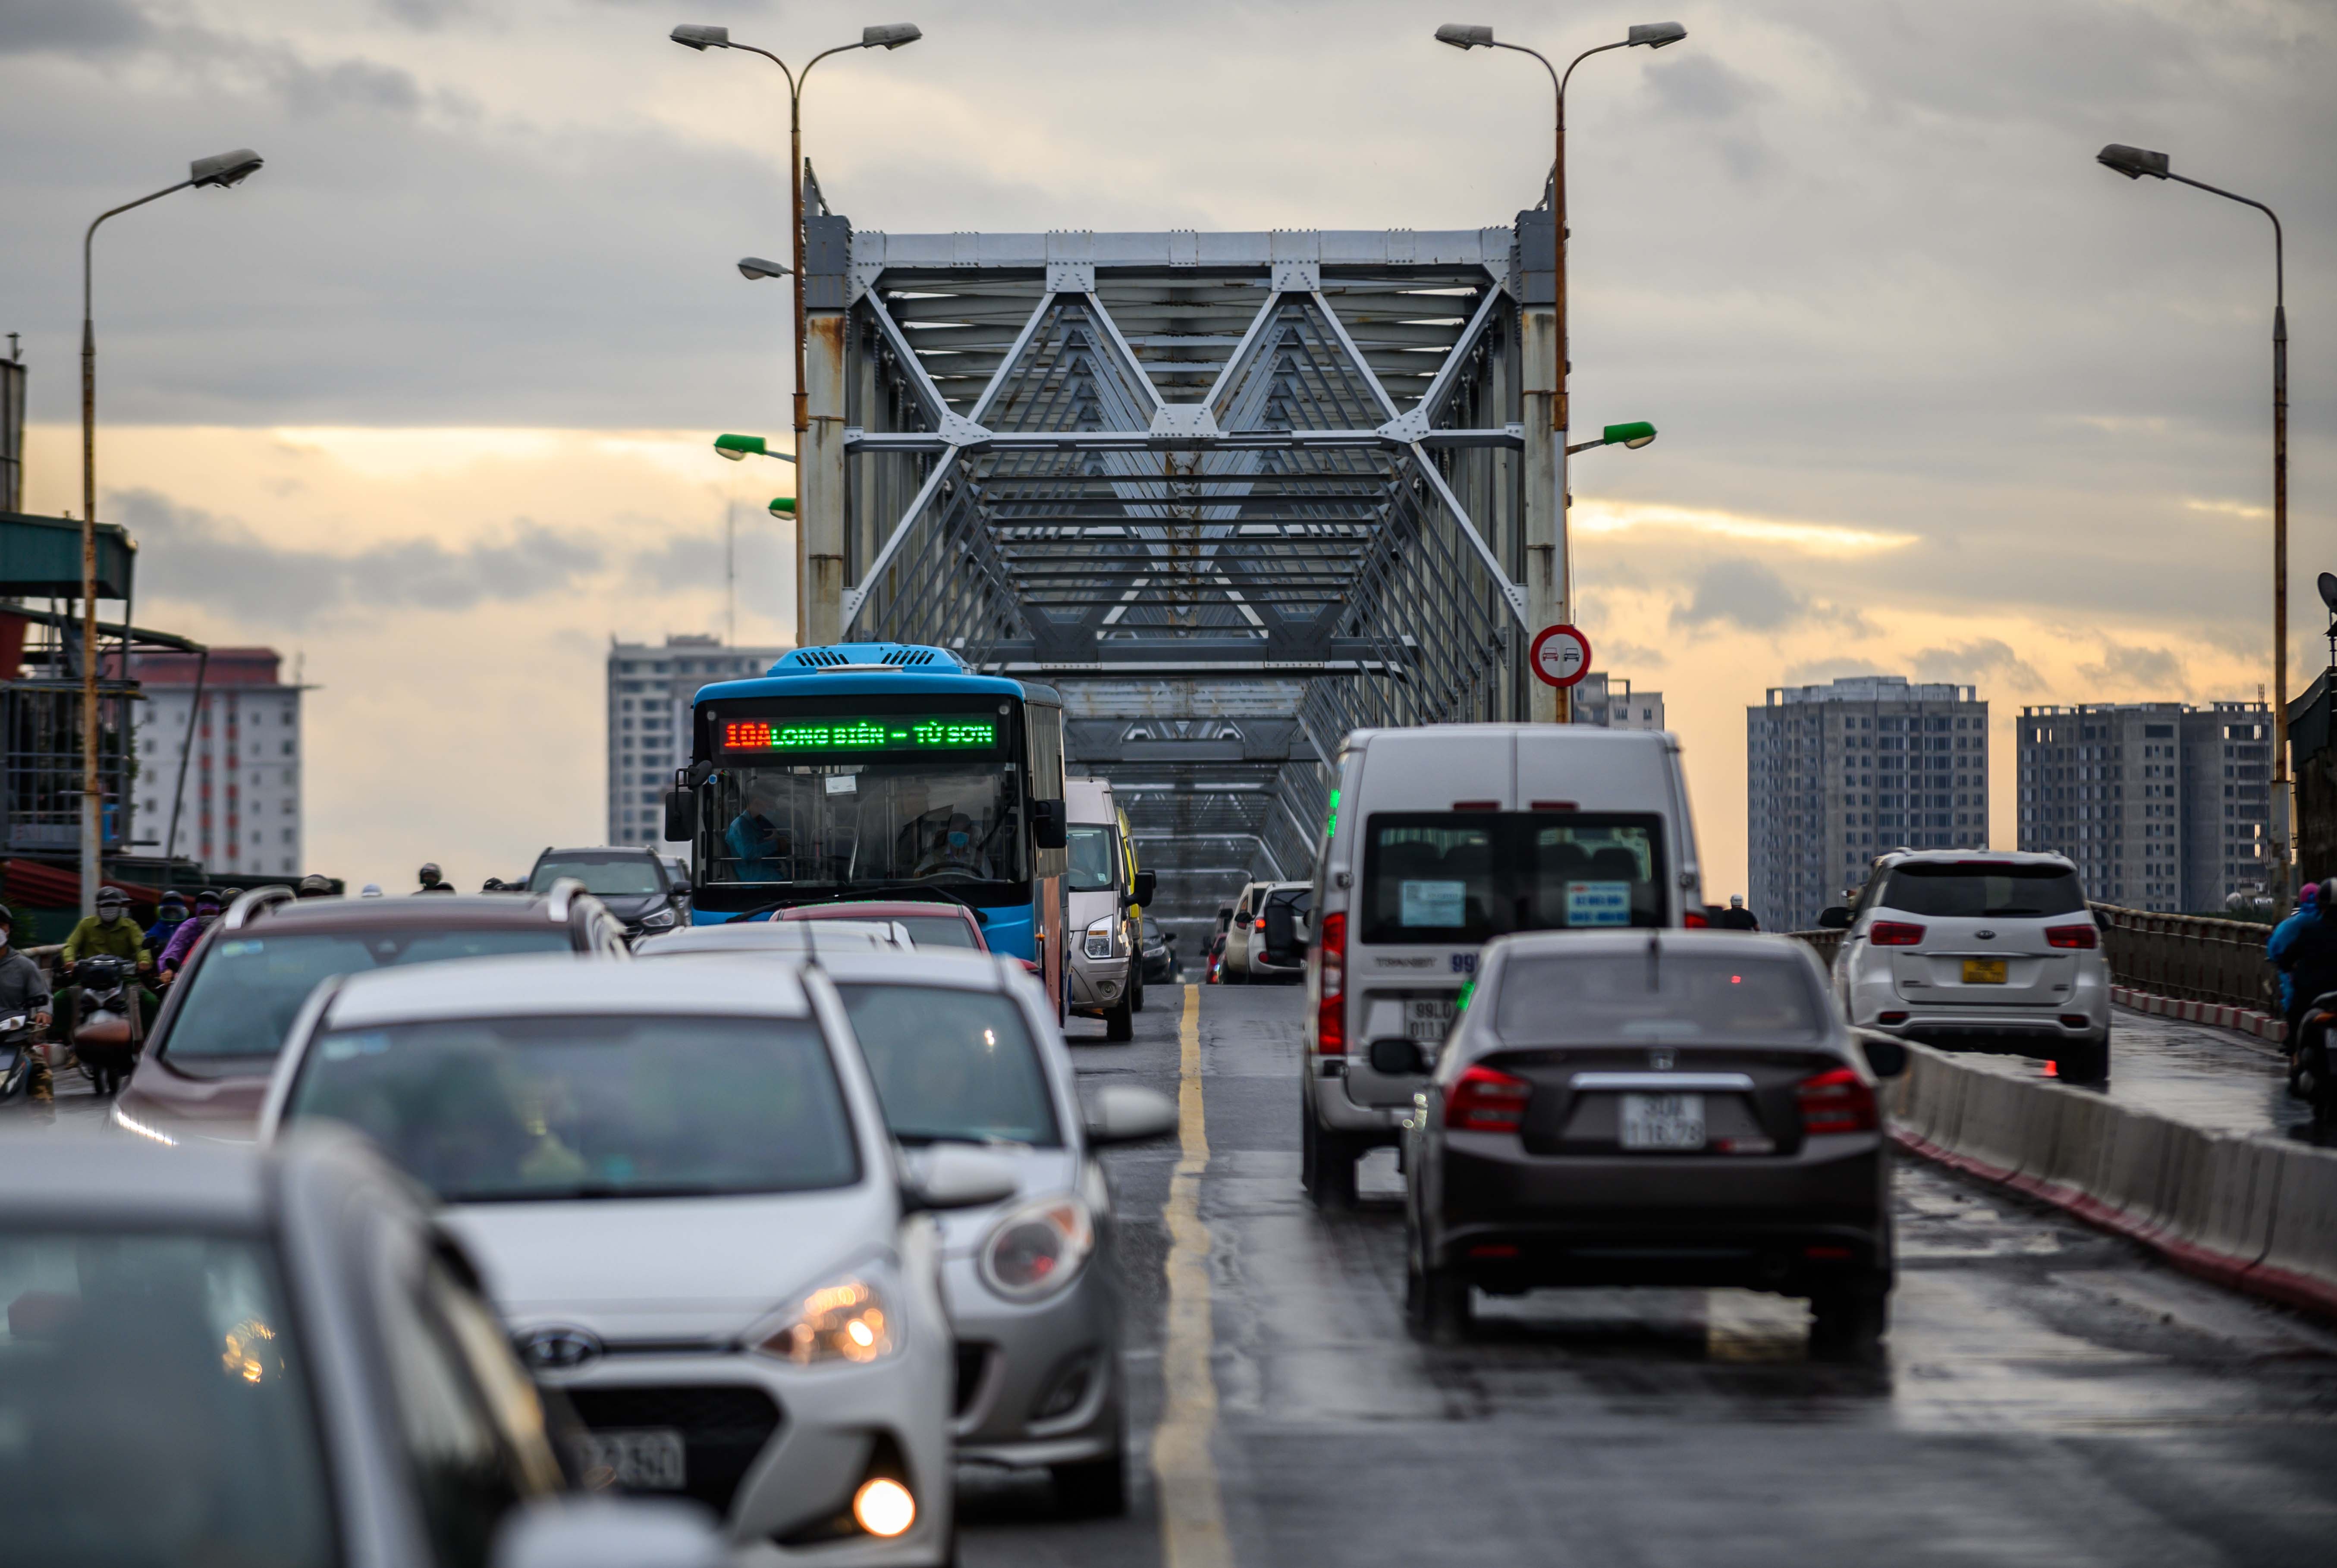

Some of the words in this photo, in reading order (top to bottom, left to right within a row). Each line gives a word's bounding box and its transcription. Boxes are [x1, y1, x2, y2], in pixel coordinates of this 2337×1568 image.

[725, 723, 771, 747] 10A
[771, 729, 828, 745] LONG
[833, 722, 883, 745] BIÊN
